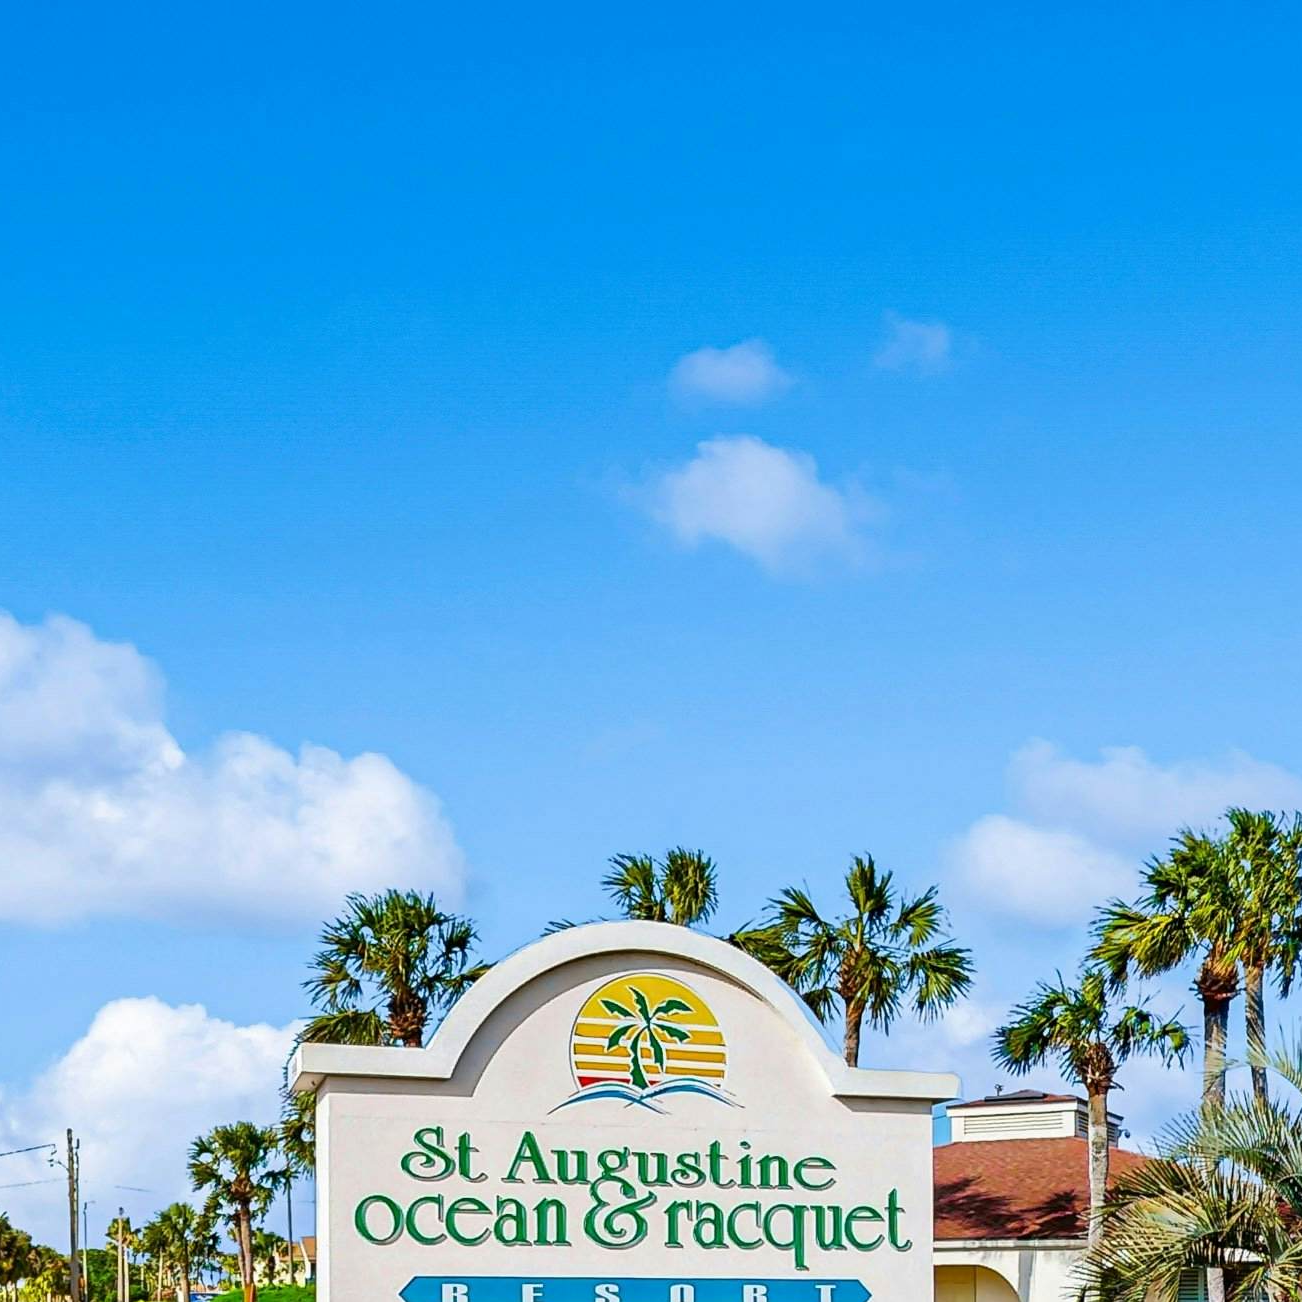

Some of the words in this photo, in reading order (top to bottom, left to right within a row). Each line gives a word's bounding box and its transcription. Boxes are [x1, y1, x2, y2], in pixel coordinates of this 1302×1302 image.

[400, 1126, 488, 1183] St
[501, 1130, 837, 1192] Augustine
[354, 1193, 572, 1247] ocean
[583, 1175, 658, 1250] &
[664, 1188, 913, 1271] racquet
